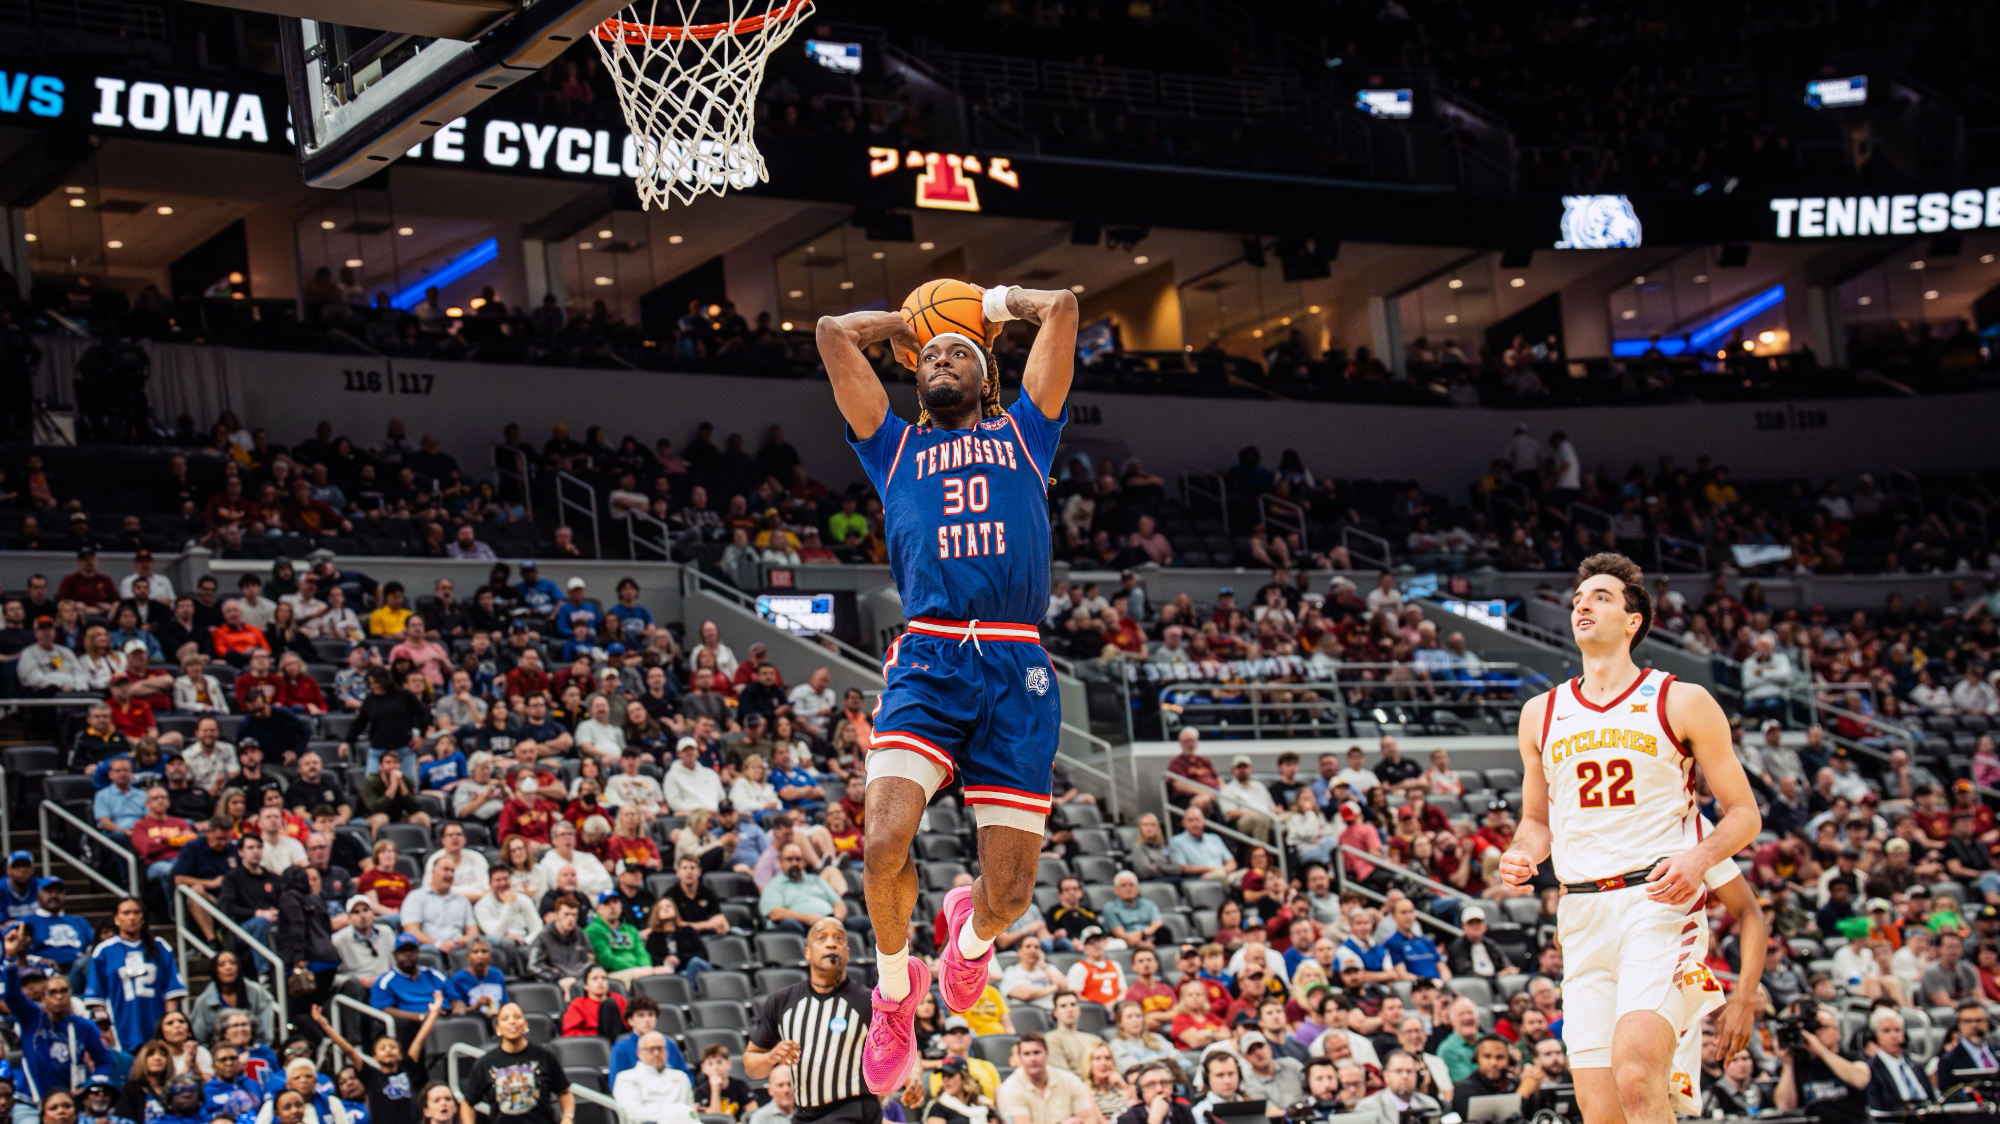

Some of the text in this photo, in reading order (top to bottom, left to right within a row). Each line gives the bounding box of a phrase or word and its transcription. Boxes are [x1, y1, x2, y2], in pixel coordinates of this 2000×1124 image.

[92, 76, 269, 143] IOWA
[484, 119, 759, 188] CYCLONES
[343, 369, 435, 395] 116 117
[915, 434, 1017, 482] TENNESSEE
[942, 474, 990, 516] 30
[937, 521, 1007, 560] STATE
[1551, 728, 1658, 764] CYCLONES
[1576, 757, 1637, 809] 22
